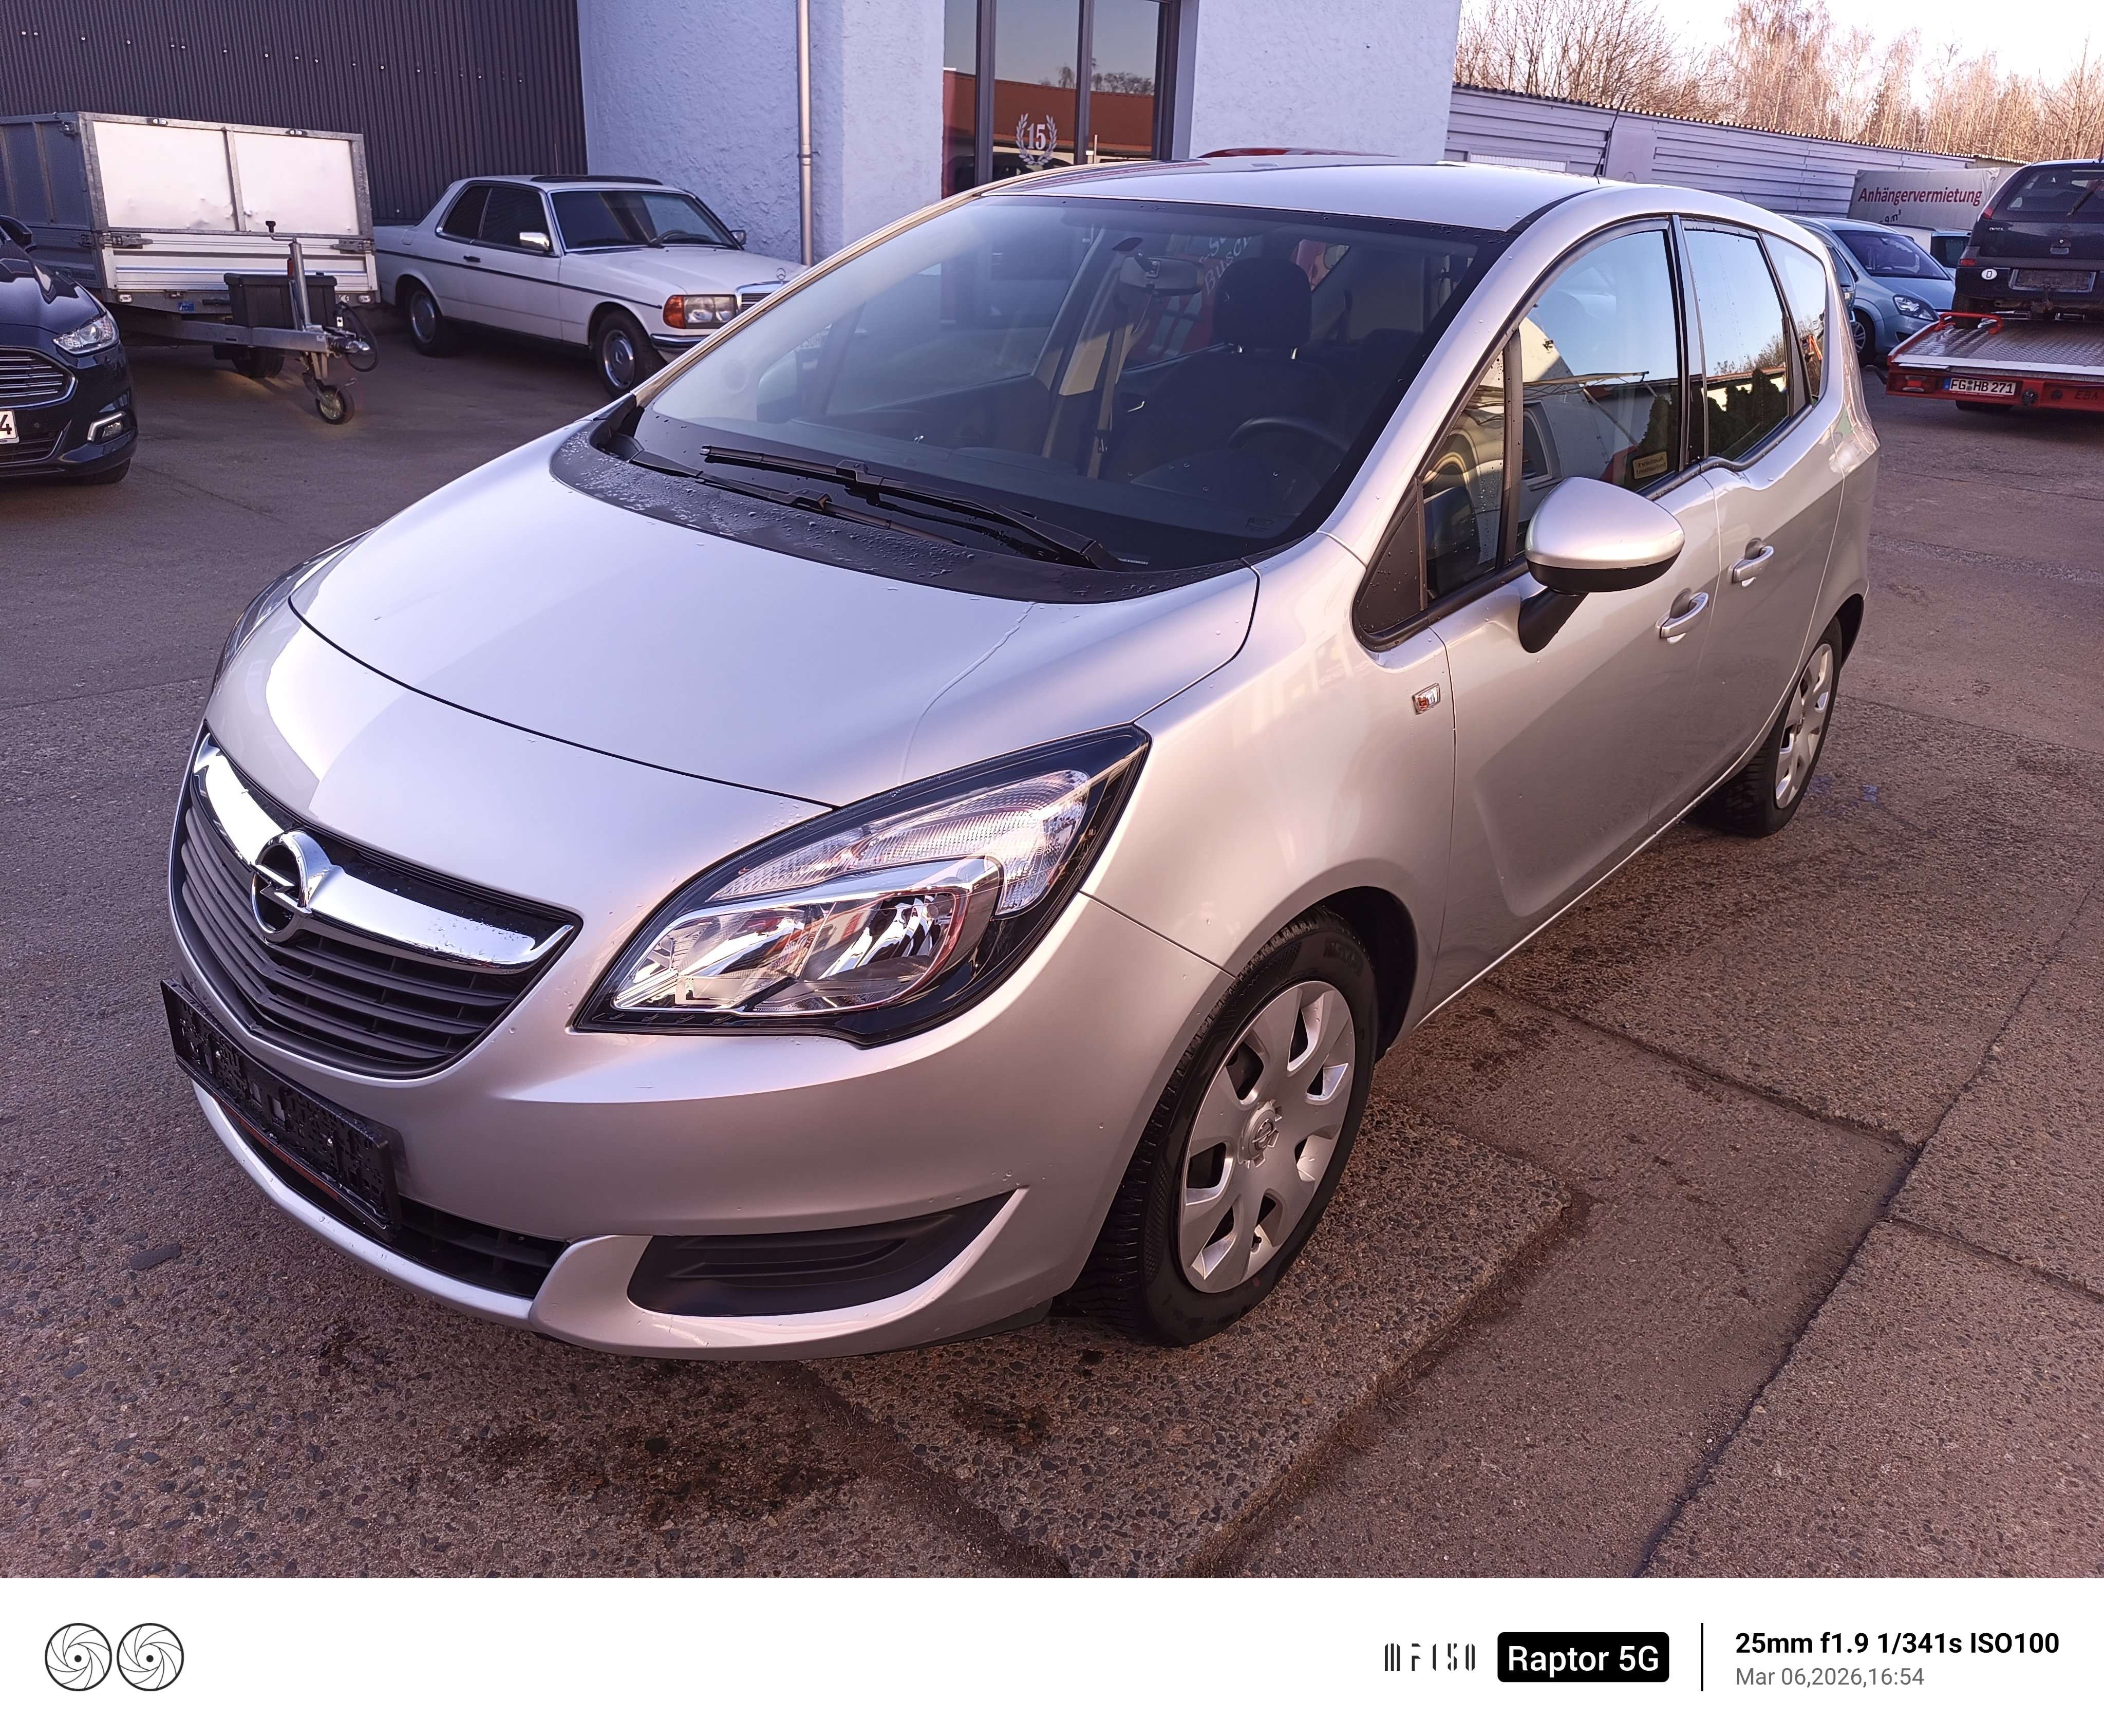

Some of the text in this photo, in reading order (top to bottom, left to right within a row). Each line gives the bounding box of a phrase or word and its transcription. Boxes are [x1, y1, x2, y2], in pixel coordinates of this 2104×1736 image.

[1027, 123, 1046, 150] 15
[1857, 187, 1982, 206] Anhängervermietung
[1950, 379, 2013, 394] FG HB 271
[0, 415, 12, 435] 4
